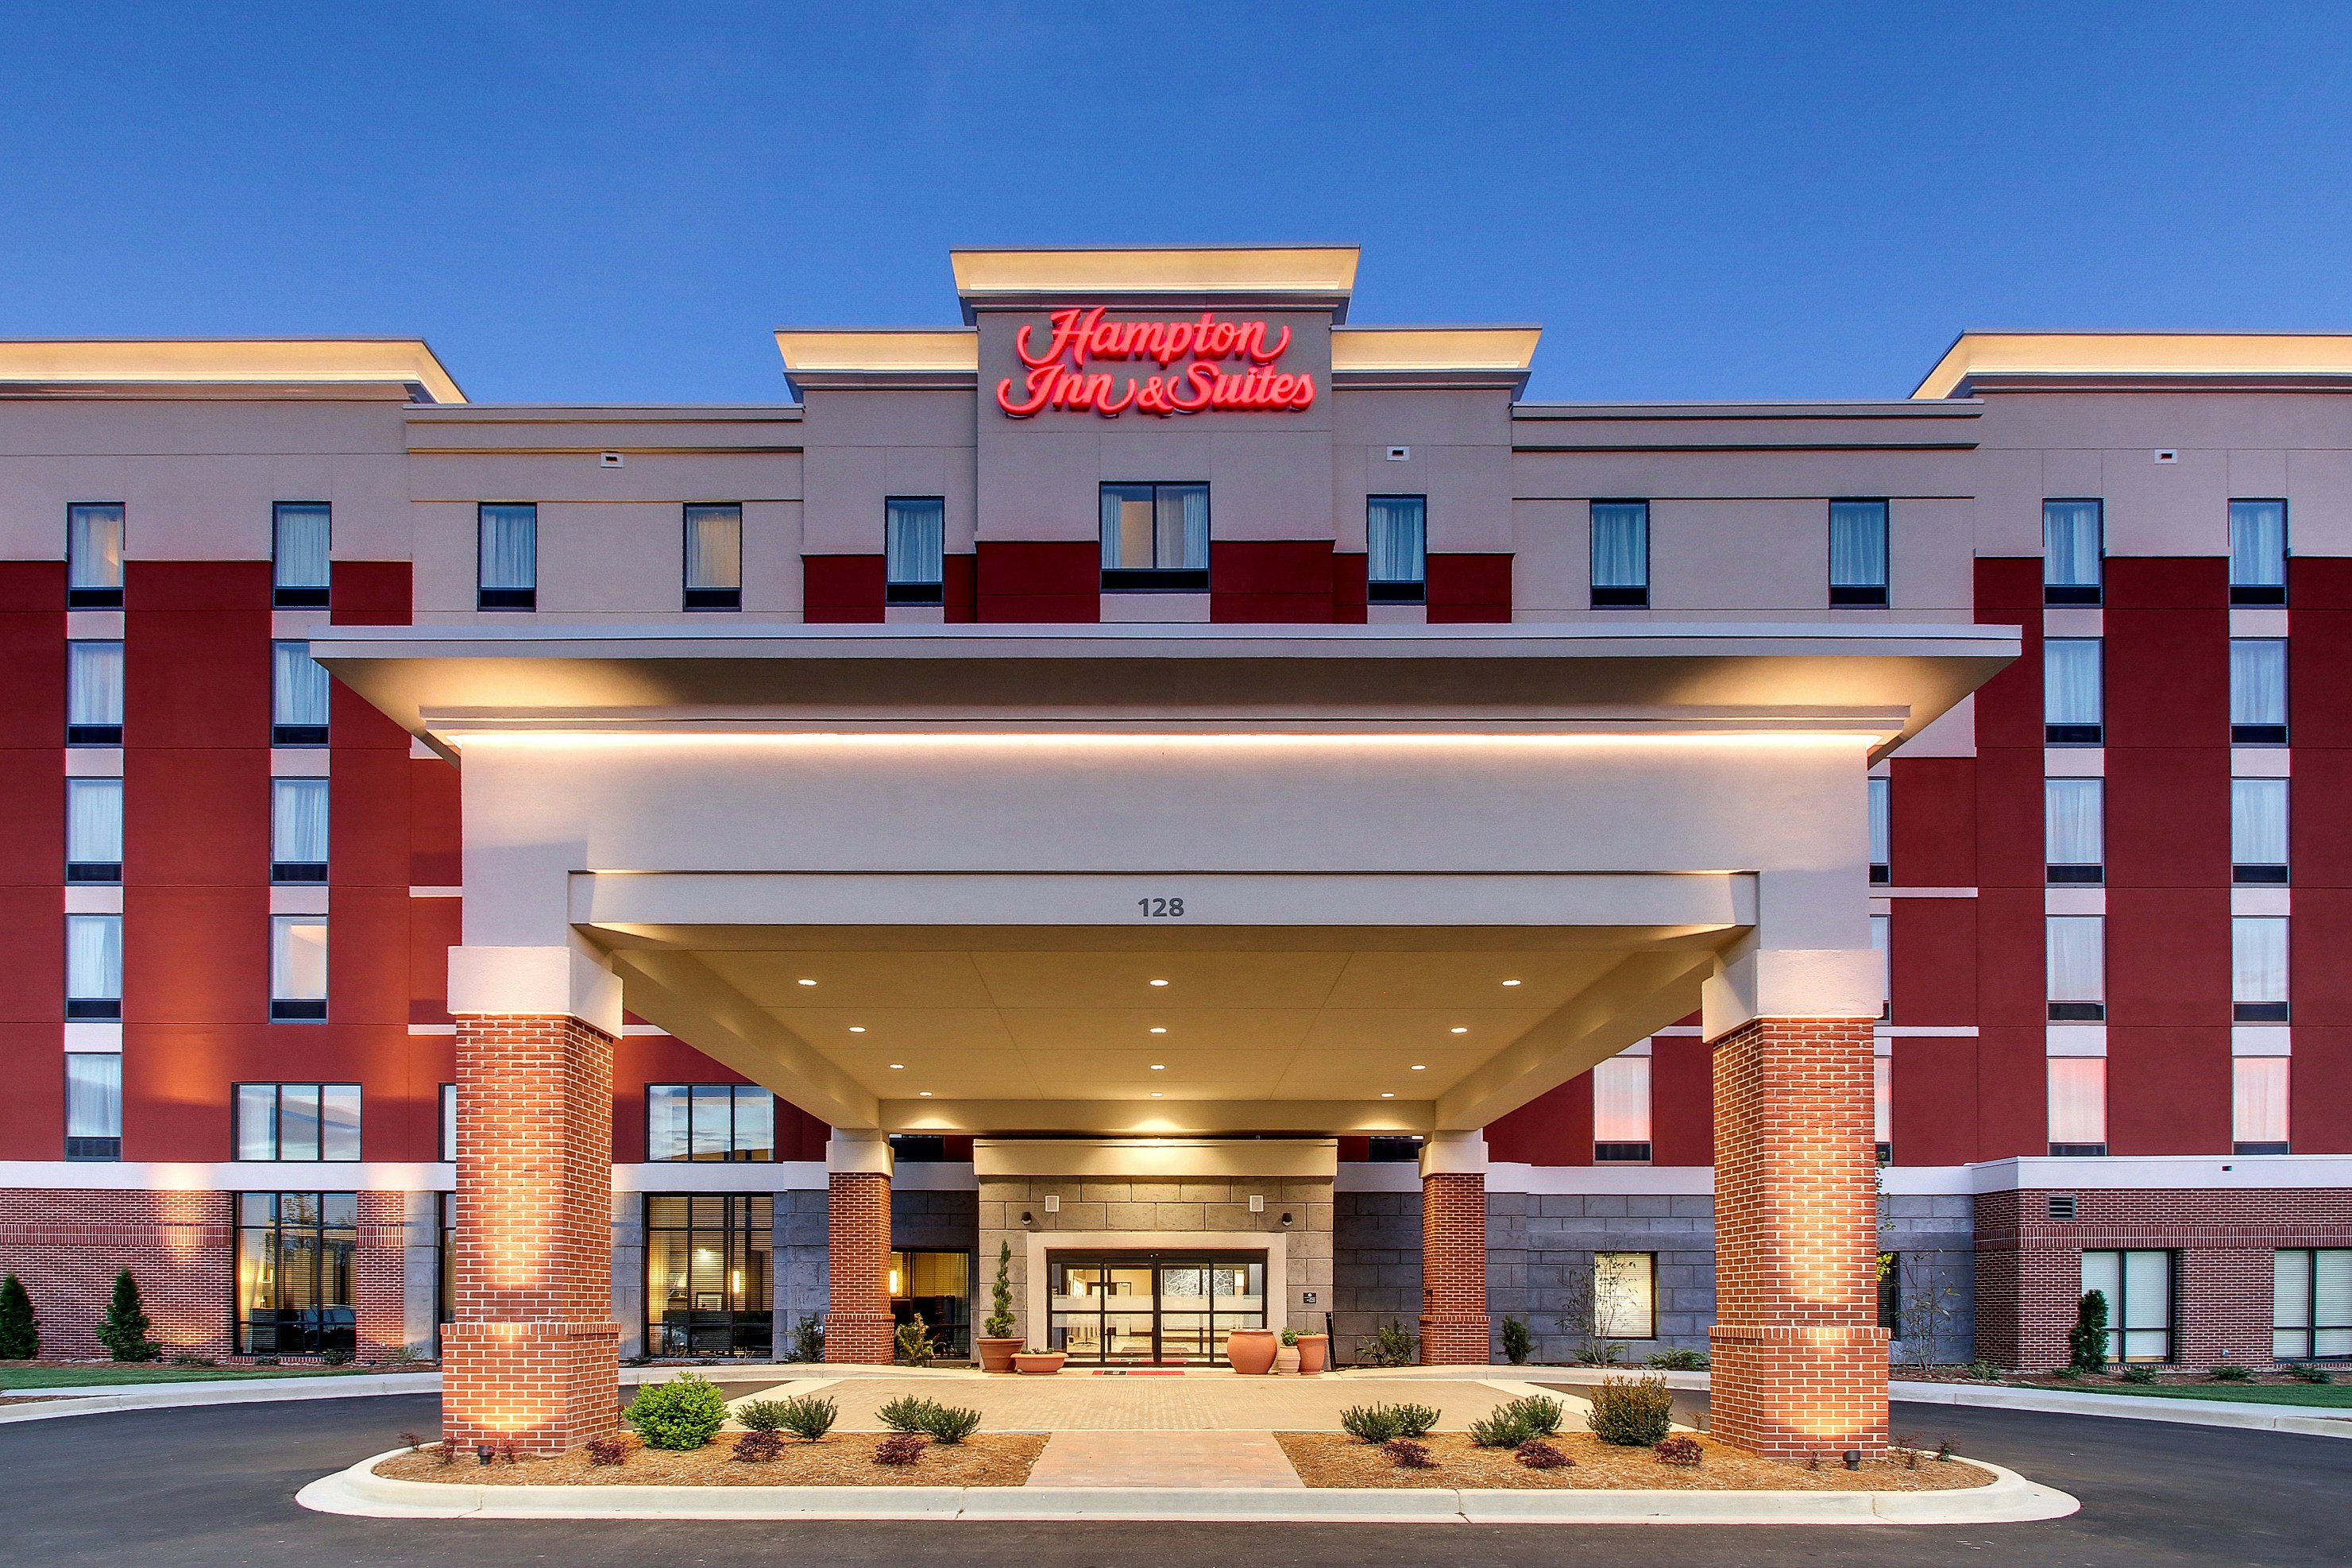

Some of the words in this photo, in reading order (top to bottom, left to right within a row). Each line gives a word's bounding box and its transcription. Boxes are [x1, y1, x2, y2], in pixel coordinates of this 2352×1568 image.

[1017, 307, 1290, 369] Hampton
[997, 364, 1136, 416] Inn
[1137, 376, 1174, 415] &
[1166, 361, 1314, 412] Suites
[1137, 898, 1184, 917] 128
